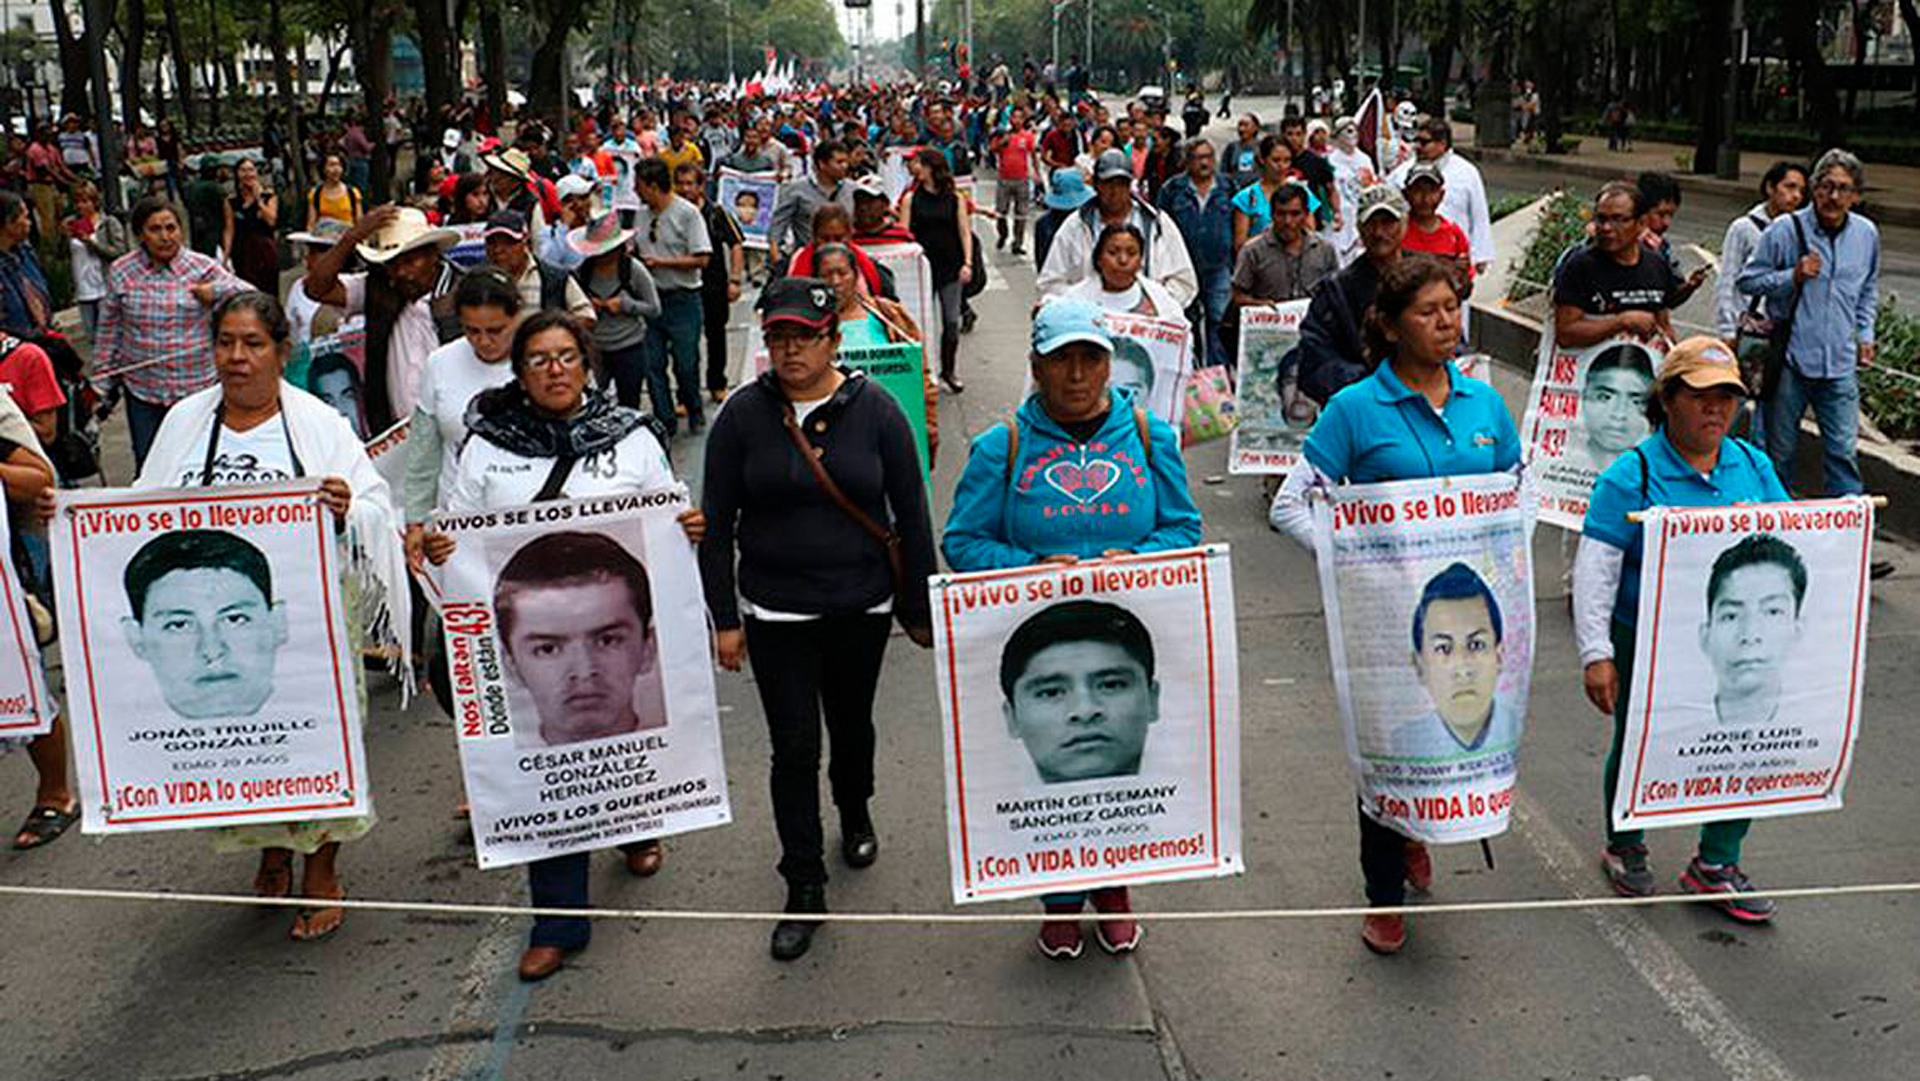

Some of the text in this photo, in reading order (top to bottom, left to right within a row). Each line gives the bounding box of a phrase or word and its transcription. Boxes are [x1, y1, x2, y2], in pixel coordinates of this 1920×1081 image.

[583, 450, 618, 479] 43
[80, 503, 313, 538] ¡Vivo se lo llevaron!
[504, 510, 529, 525] SE
[535, 505, 573, 522] LOS
[1334, 501, 1396, 531] ¡Vivo
[1403, 498, 1429, 521] se
[1434, 494, 1456, 517] lo
[1670, 513, 1725, 538] ¡Vivo
[1730, 512, 1750, 533] se
[1756, 510, 1775, 531] lo
[953, 561, 1199, 616] ¡Vivo se lo llevaron!
[442, 602, 491, 736] Nos faltan 43!
[1678, 738, 1820, 757] LUNA TORRES
[1758, 727, 1802, 740] LUIS
[518, 735, 669, 773] CÉSAR MANUEL
[115, 771, 341, 811] ¡Con VIDA lo queremos!
[1067, 785, 1178, 808] GETSEMANY
[1641, 767, 1831, 805] ¡Con VIDA lo queremos!
[494, 779, 708, 833] ¡VIVOS LOS QUEREMOS
[1413, 796, 1465, 821] VIDA
[1468, 793, 1486, 817] lo
[977, 833, 1205, 881] ¡Con VIDA lo queremos!
